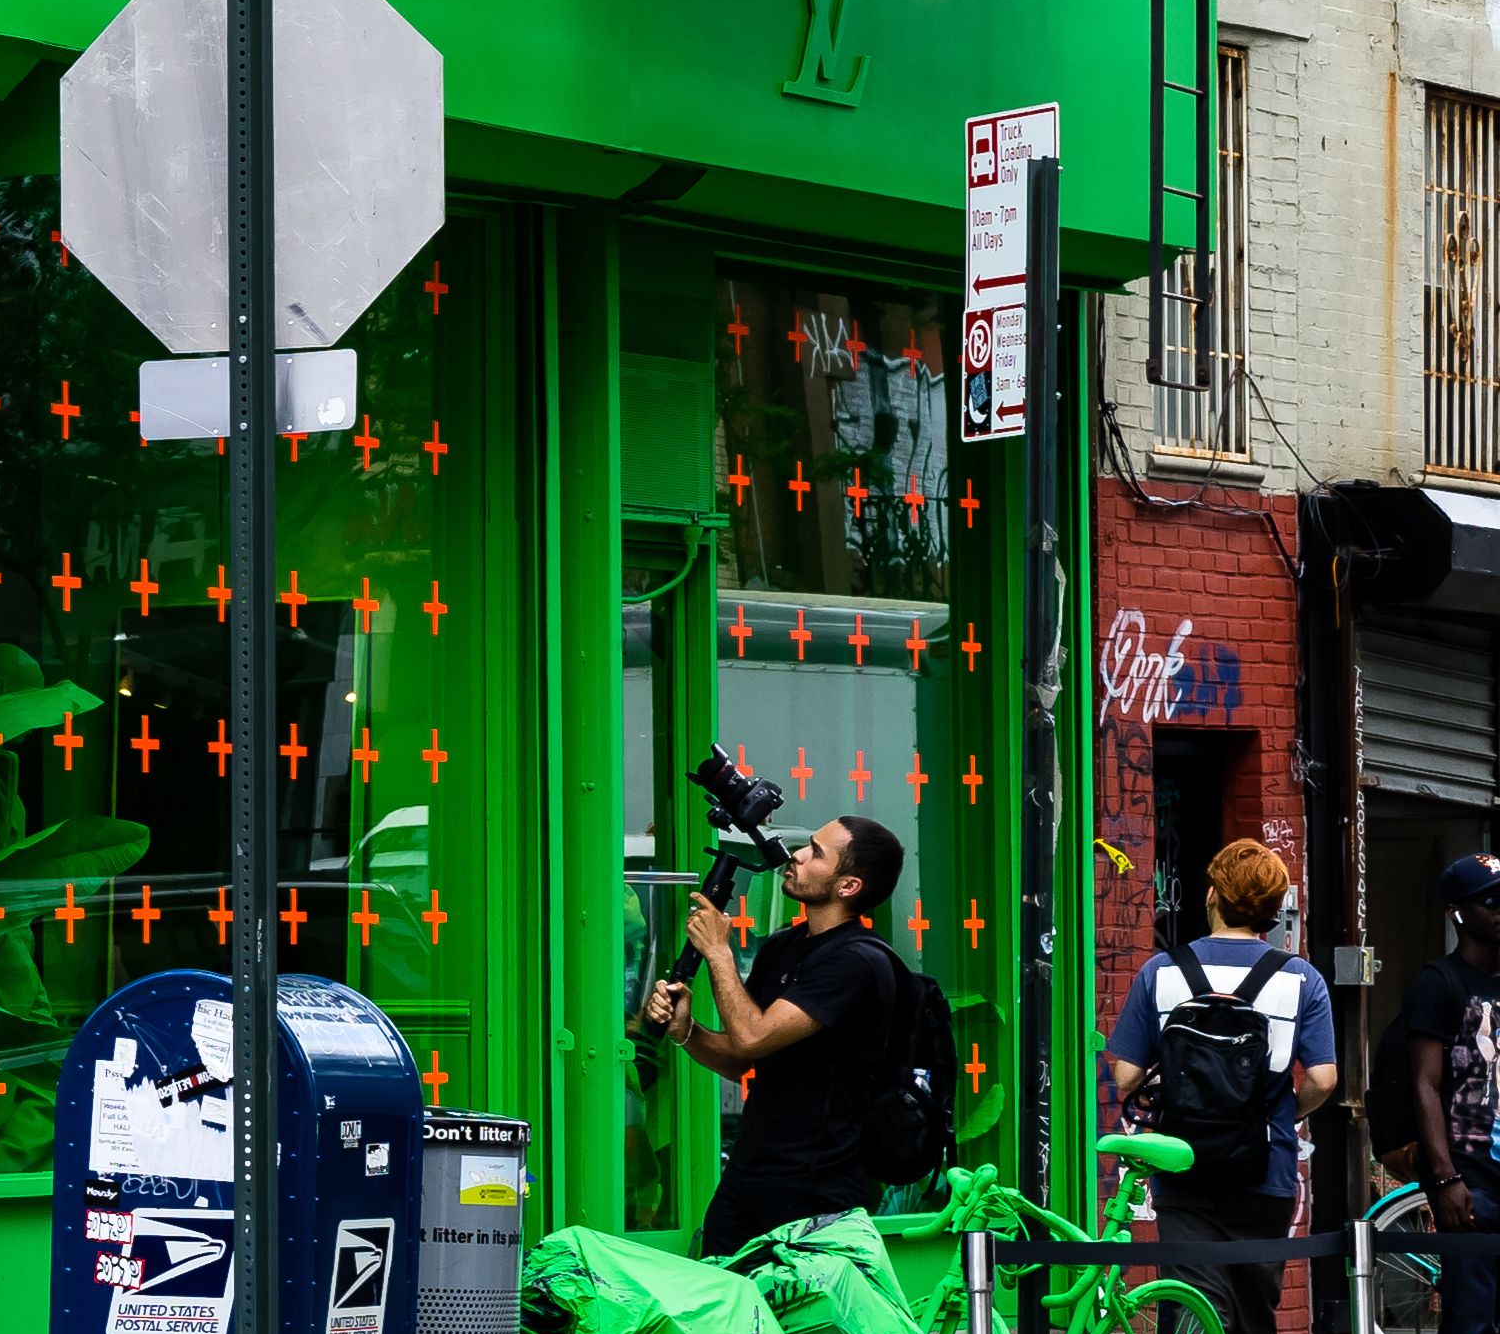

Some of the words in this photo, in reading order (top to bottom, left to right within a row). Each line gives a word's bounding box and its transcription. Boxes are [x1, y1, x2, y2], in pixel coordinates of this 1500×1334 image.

[1000, 121, 1023, 142] Truck
[1000, 142, 1033, 163] Loading
[1001, 165, 1019, 186] Only
[971, 233, 982, 252] All
[984, 231, 1004, 253] Days
[996, 312, 1023, 329] Monday
[995, 352, 1016, 369] Friday
[479, 1126, 514, 1142] litter
[432, 1226, 474, 1244] litter
[476, 1228, 489, 1245] in
[492, 1228, 507, 1245] its
[117, 1303, 167, 1317] UNITED
[168, 1304, 216, 1318] STATES
[114, 1318, 163, 1332] POSTAL
[164, 1320, 219, 1334] SERVICE
[330, 1316, 354, 1329] UNITED
[354, 1314, 377, 1327] STATES
